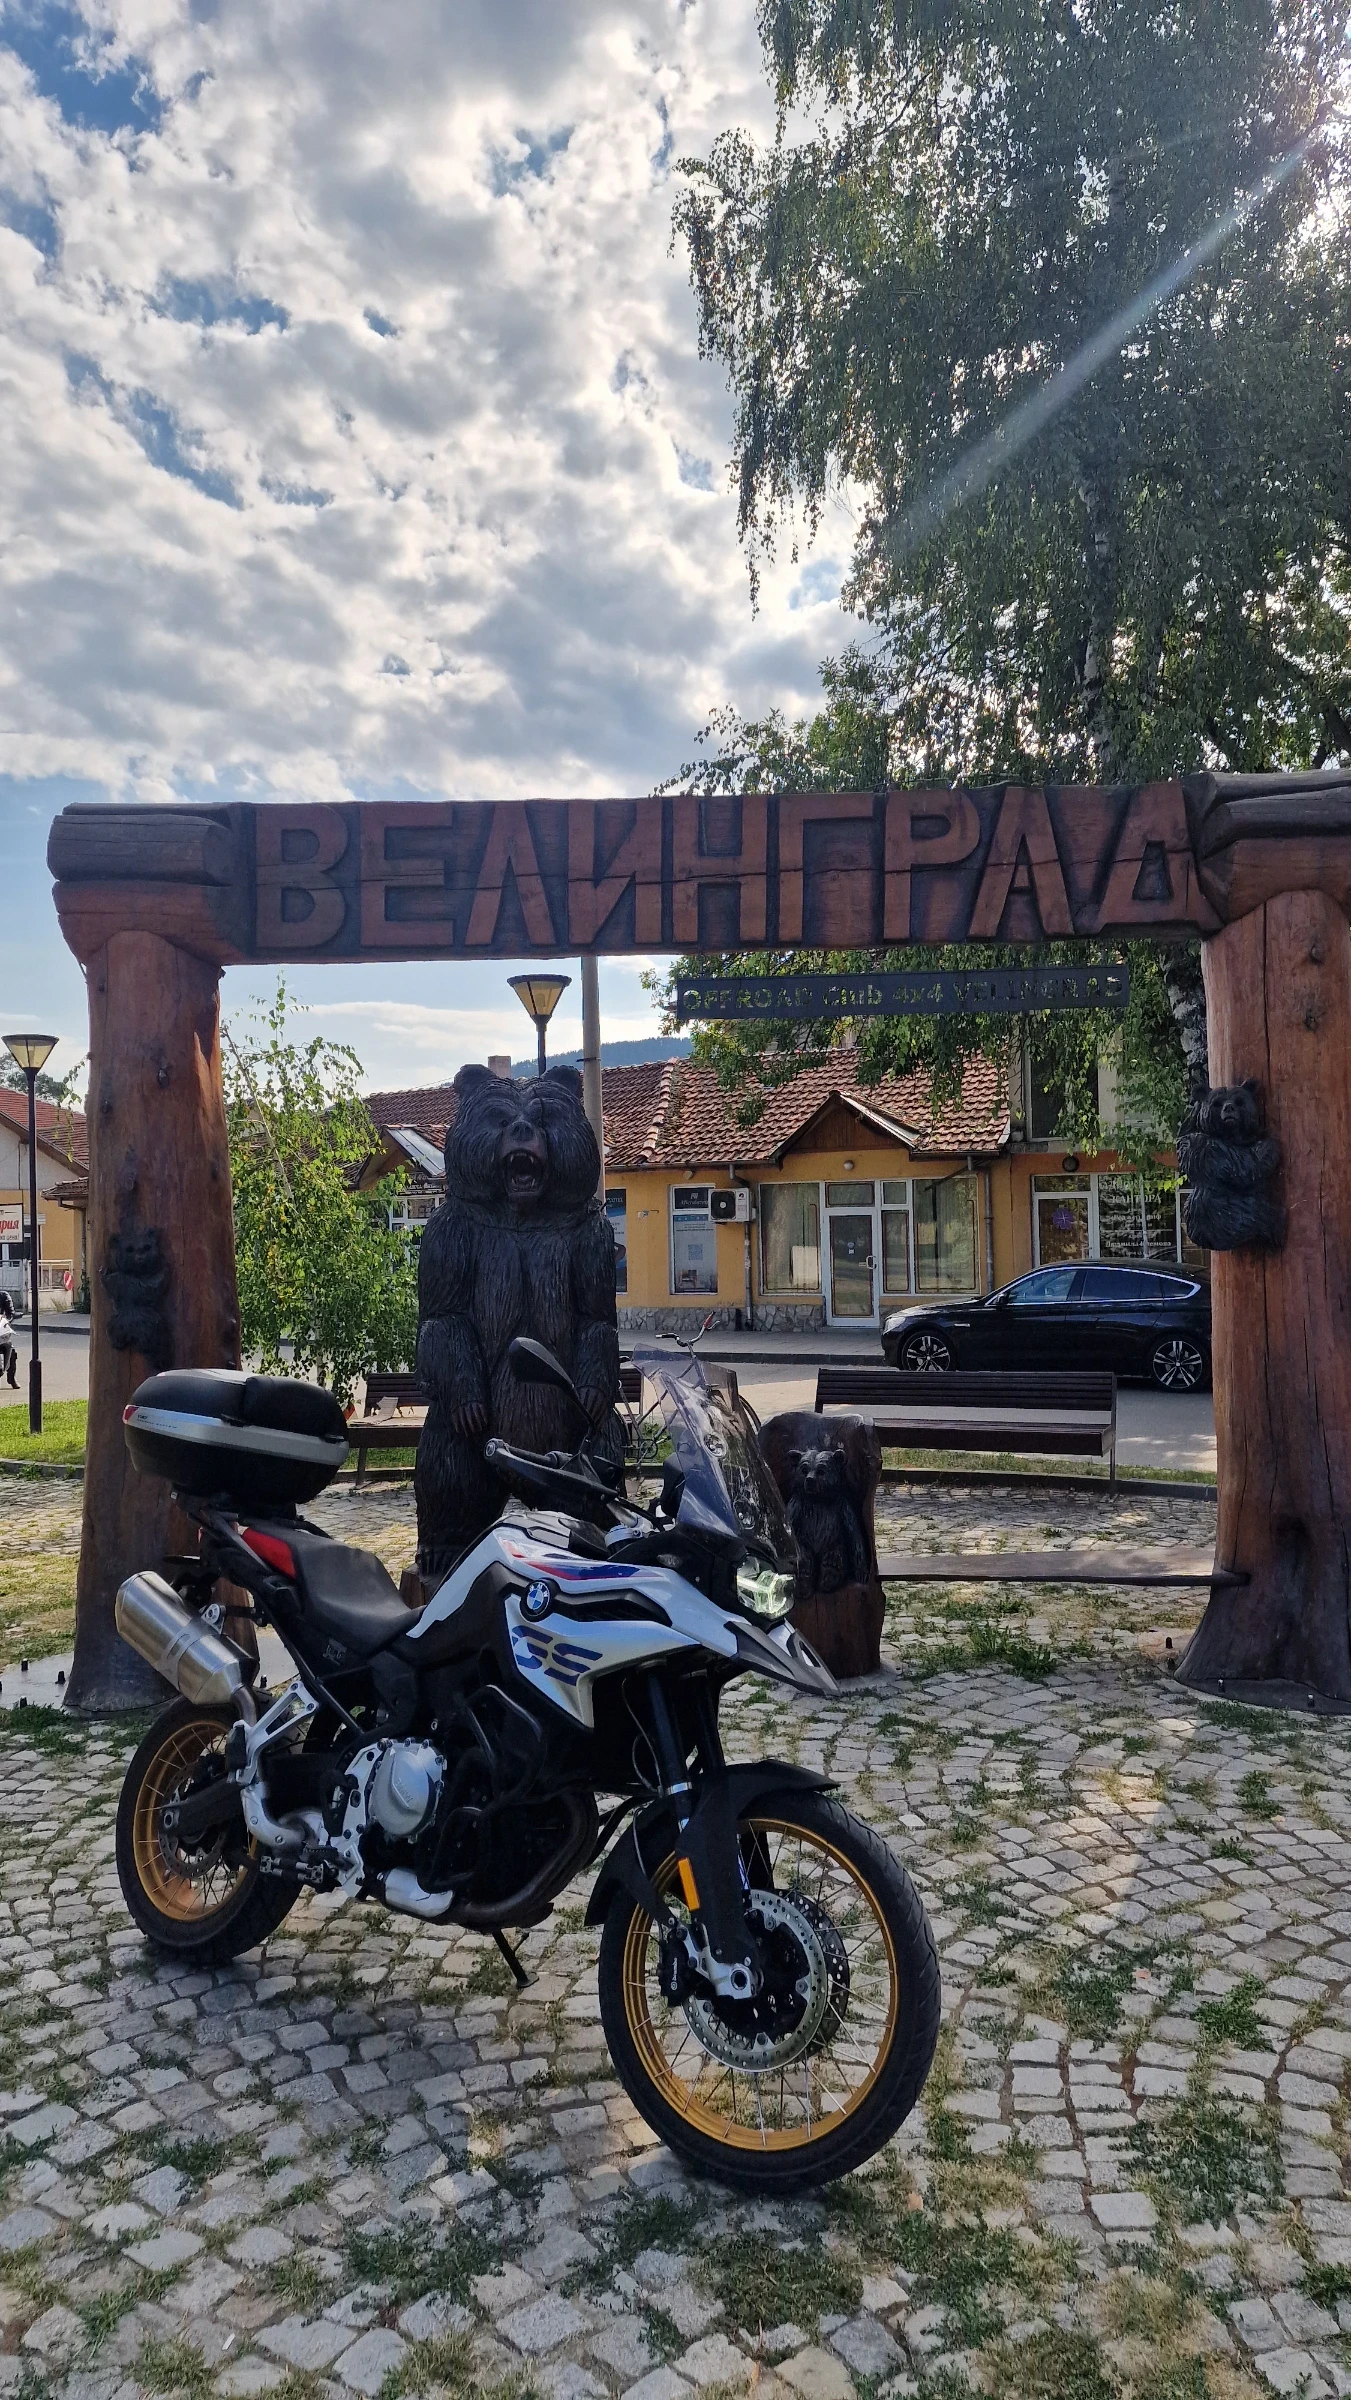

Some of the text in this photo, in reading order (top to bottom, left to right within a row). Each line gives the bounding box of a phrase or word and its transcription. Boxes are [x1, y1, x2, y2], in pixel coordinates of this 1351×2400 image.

[256, 784, 1223, 948] ВЕЛИНГРАД
[683, 976, 1123, 1010] OFFROAD Club 4x4 VELINGRAD
[511, 1624, 603, 1687] GS
